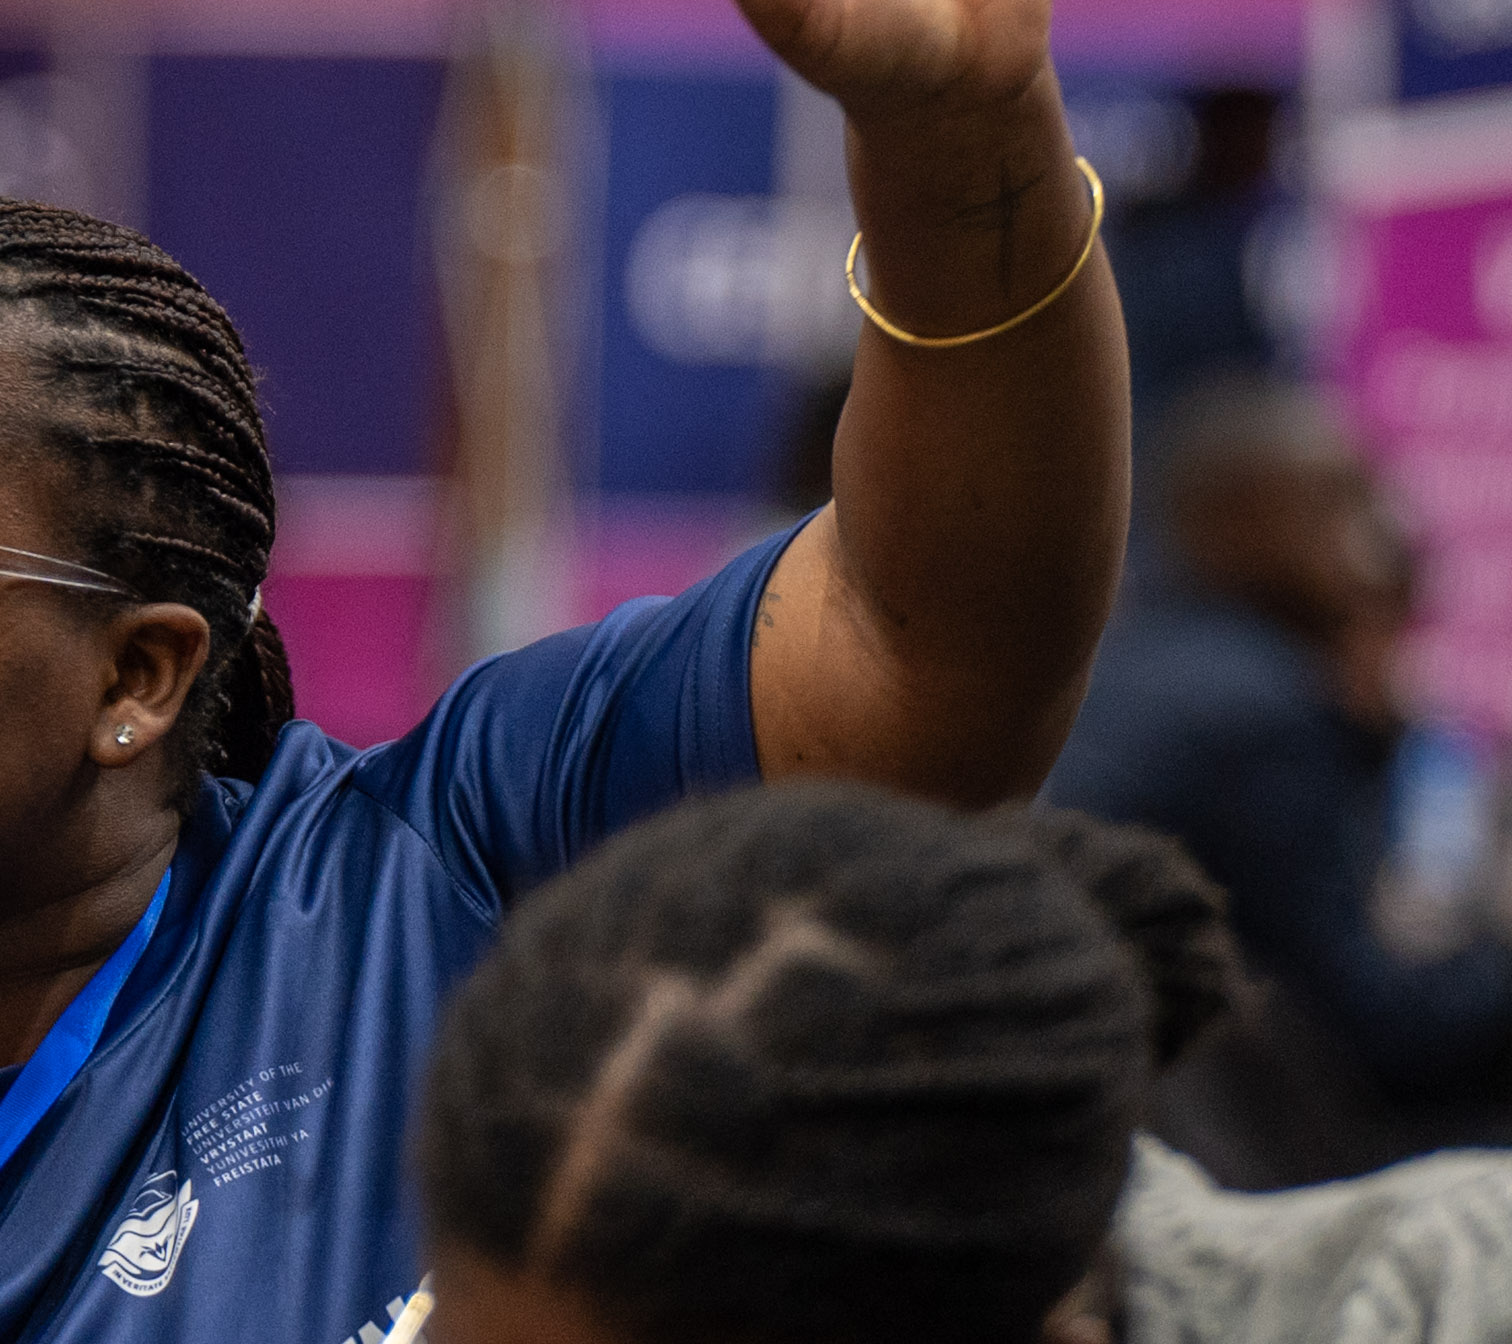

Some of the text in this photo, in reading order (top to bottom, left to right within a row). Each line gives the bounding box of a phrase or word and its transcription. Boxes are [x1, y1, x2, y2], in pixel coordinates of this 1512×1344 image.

[181, 1062, 304, 1137] UNIVERSITY OF THE
[186, 1090, 264, 1145] FREE STATE
[192, 1101, 281, 1155] UNIVERSITEIT
[283, 1093, 311, 1111] VAN
[200, 1122, 269, 1165] VRYSTAAT
[206, 1128, 310, 1175] YUNIVESITHI YA
[213, 1154, 282, 1187] FREISTATA
